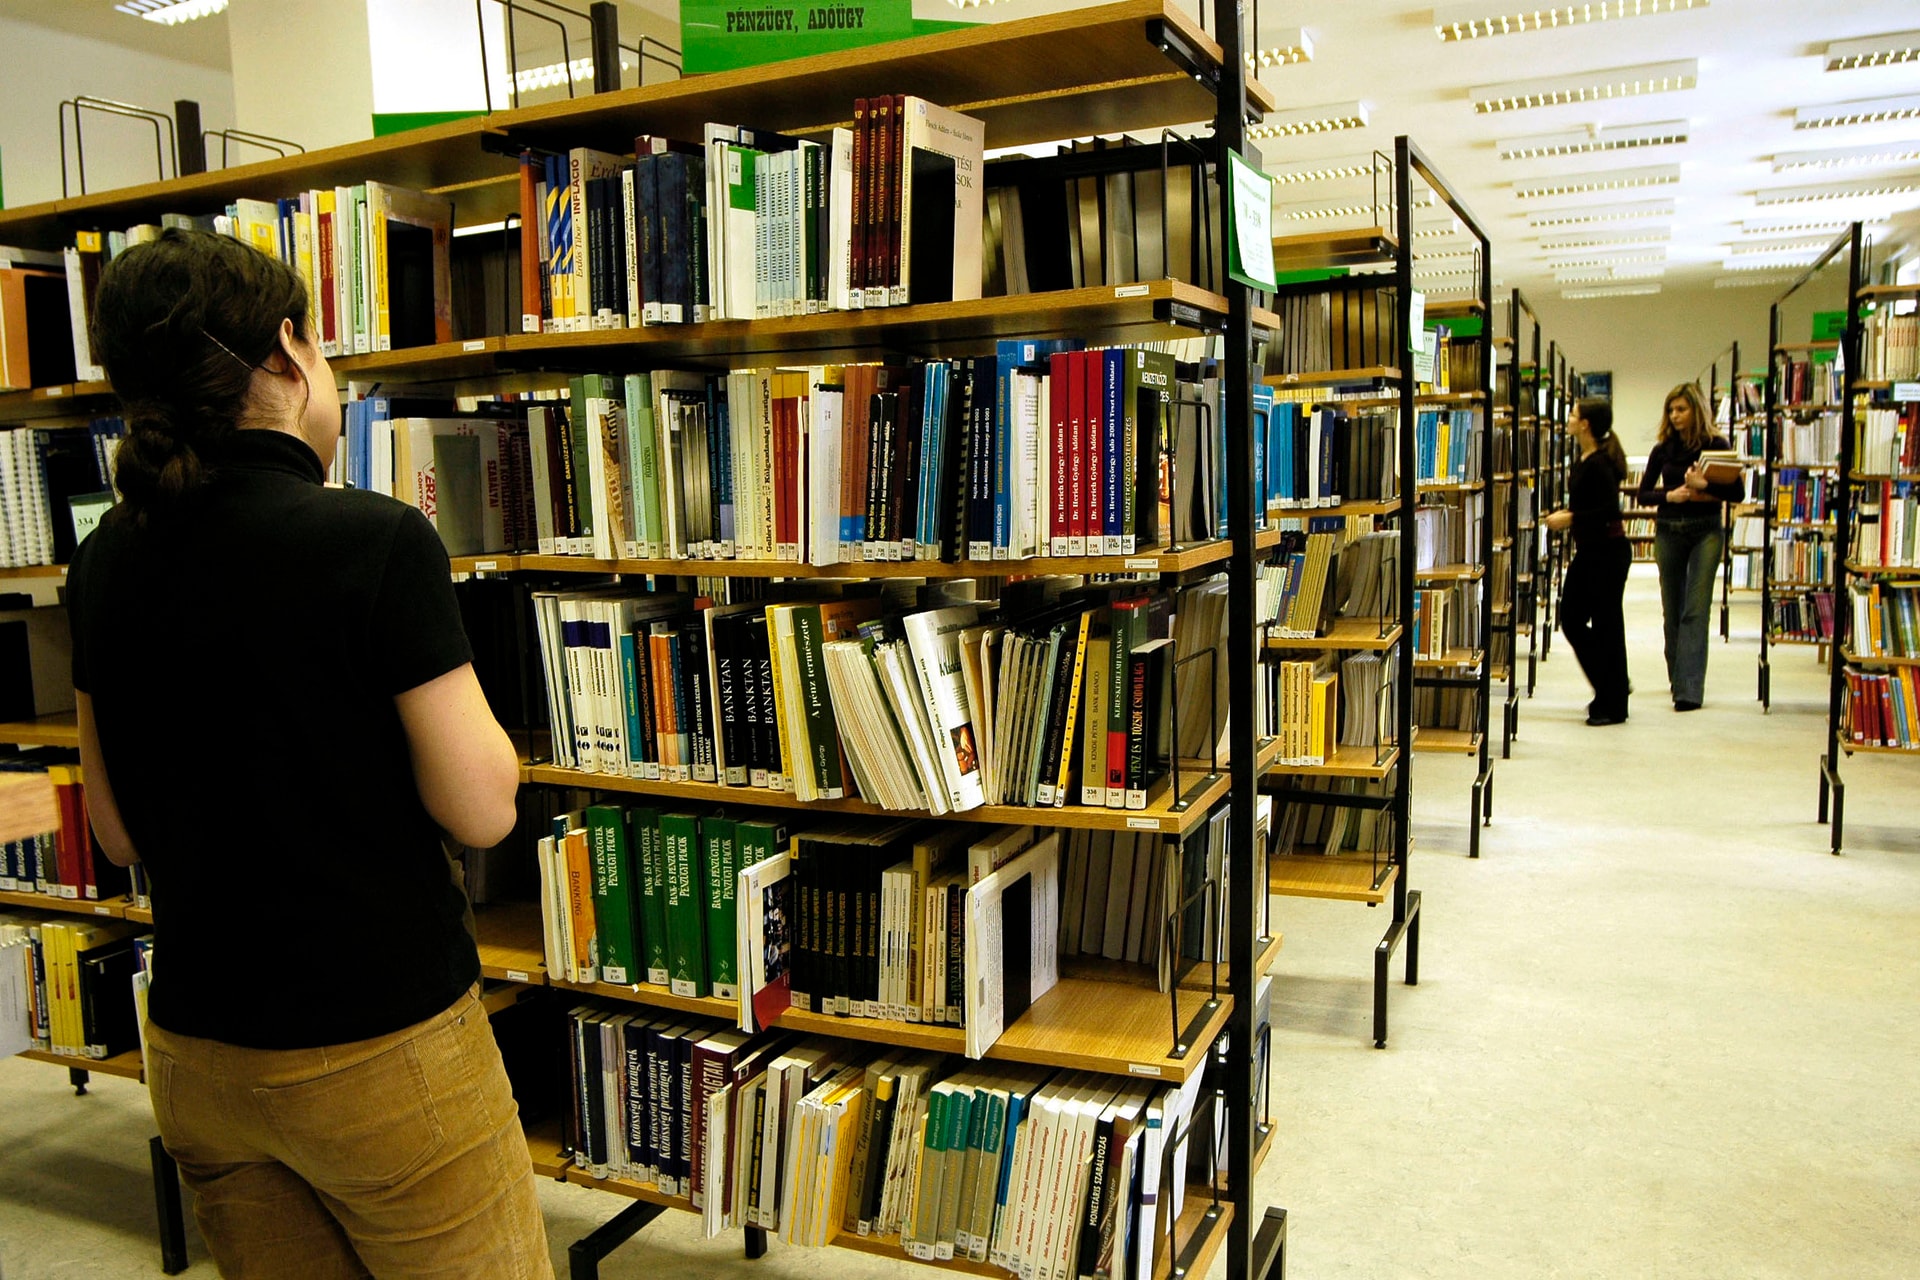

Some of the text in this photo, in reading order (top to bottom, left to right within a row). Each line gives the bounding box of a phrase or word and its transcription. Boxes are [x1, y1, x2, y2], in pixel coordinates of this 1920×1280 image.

[727, 7, 864, 33] PÉNZÜGY, ADÓÜGY
[762, 378, 771, 425] pénzügyek
[1110, 390, 1115, 398] és
[560, 425, 571, 479] BANKÜZEMTAN
[1089, 426, 1097, 451] Adótan
[763, 426, 772, 484] Külgazdasági
[1072, 453, 1080, 481] György:
[1090, 453, 1099, 481] György:
[1057, 456, 1066, 484] György:
[1109, 455, 1117, 484] György:
[487, 460, 499, 508] SZABÁLYAI
[78, 518, 94, 527] 334
[765, 525, 773, 553] Gellért
[721, 658, 735, 722] BANKTAN
[743, 658, 757, 722] BANKTAN
[760, 659, 774, 724] BANKTAN
[800, 618, 826, 766] György A pénz természete
[1114, 660, 1122, 718] KERESKEDELMI
[1132, 711, 1143, 735] TŐZSDE
[1132, 745, 1142, 753] ÉS
[1131, 755, 1142, 773] PÉNZ
[598, 865, 605, 874] ÉS
[606, 827, 618, 886] PÉNZÜGYI PIACOK
[644, 865, 651, 874] ÉS
[678, 837, 690, 896] PÉNZÜGYI PIACOK
[721, 839, 734, 899] PÉNZÜGYI PIACOK
[599, 876, 607, 895] BANK-
[645, 875, 653, 896] BANK-
[669, 874, 677, 883] ÉS
[711, 876, 720, 887] ÉS
[571, 871, 582, 916] BANKING
[669, 885, 678, 905] BANK-
[712, 889, 721, 908] BANK-
[627, 1049, 643, 1147] Közösségi pénzügyek
[658, 1060, 674, 1159] Közösségi pénzügyek
[1089, 1136, 1107, 1226] MONETÁRIS SZABÁLYOZÁS
